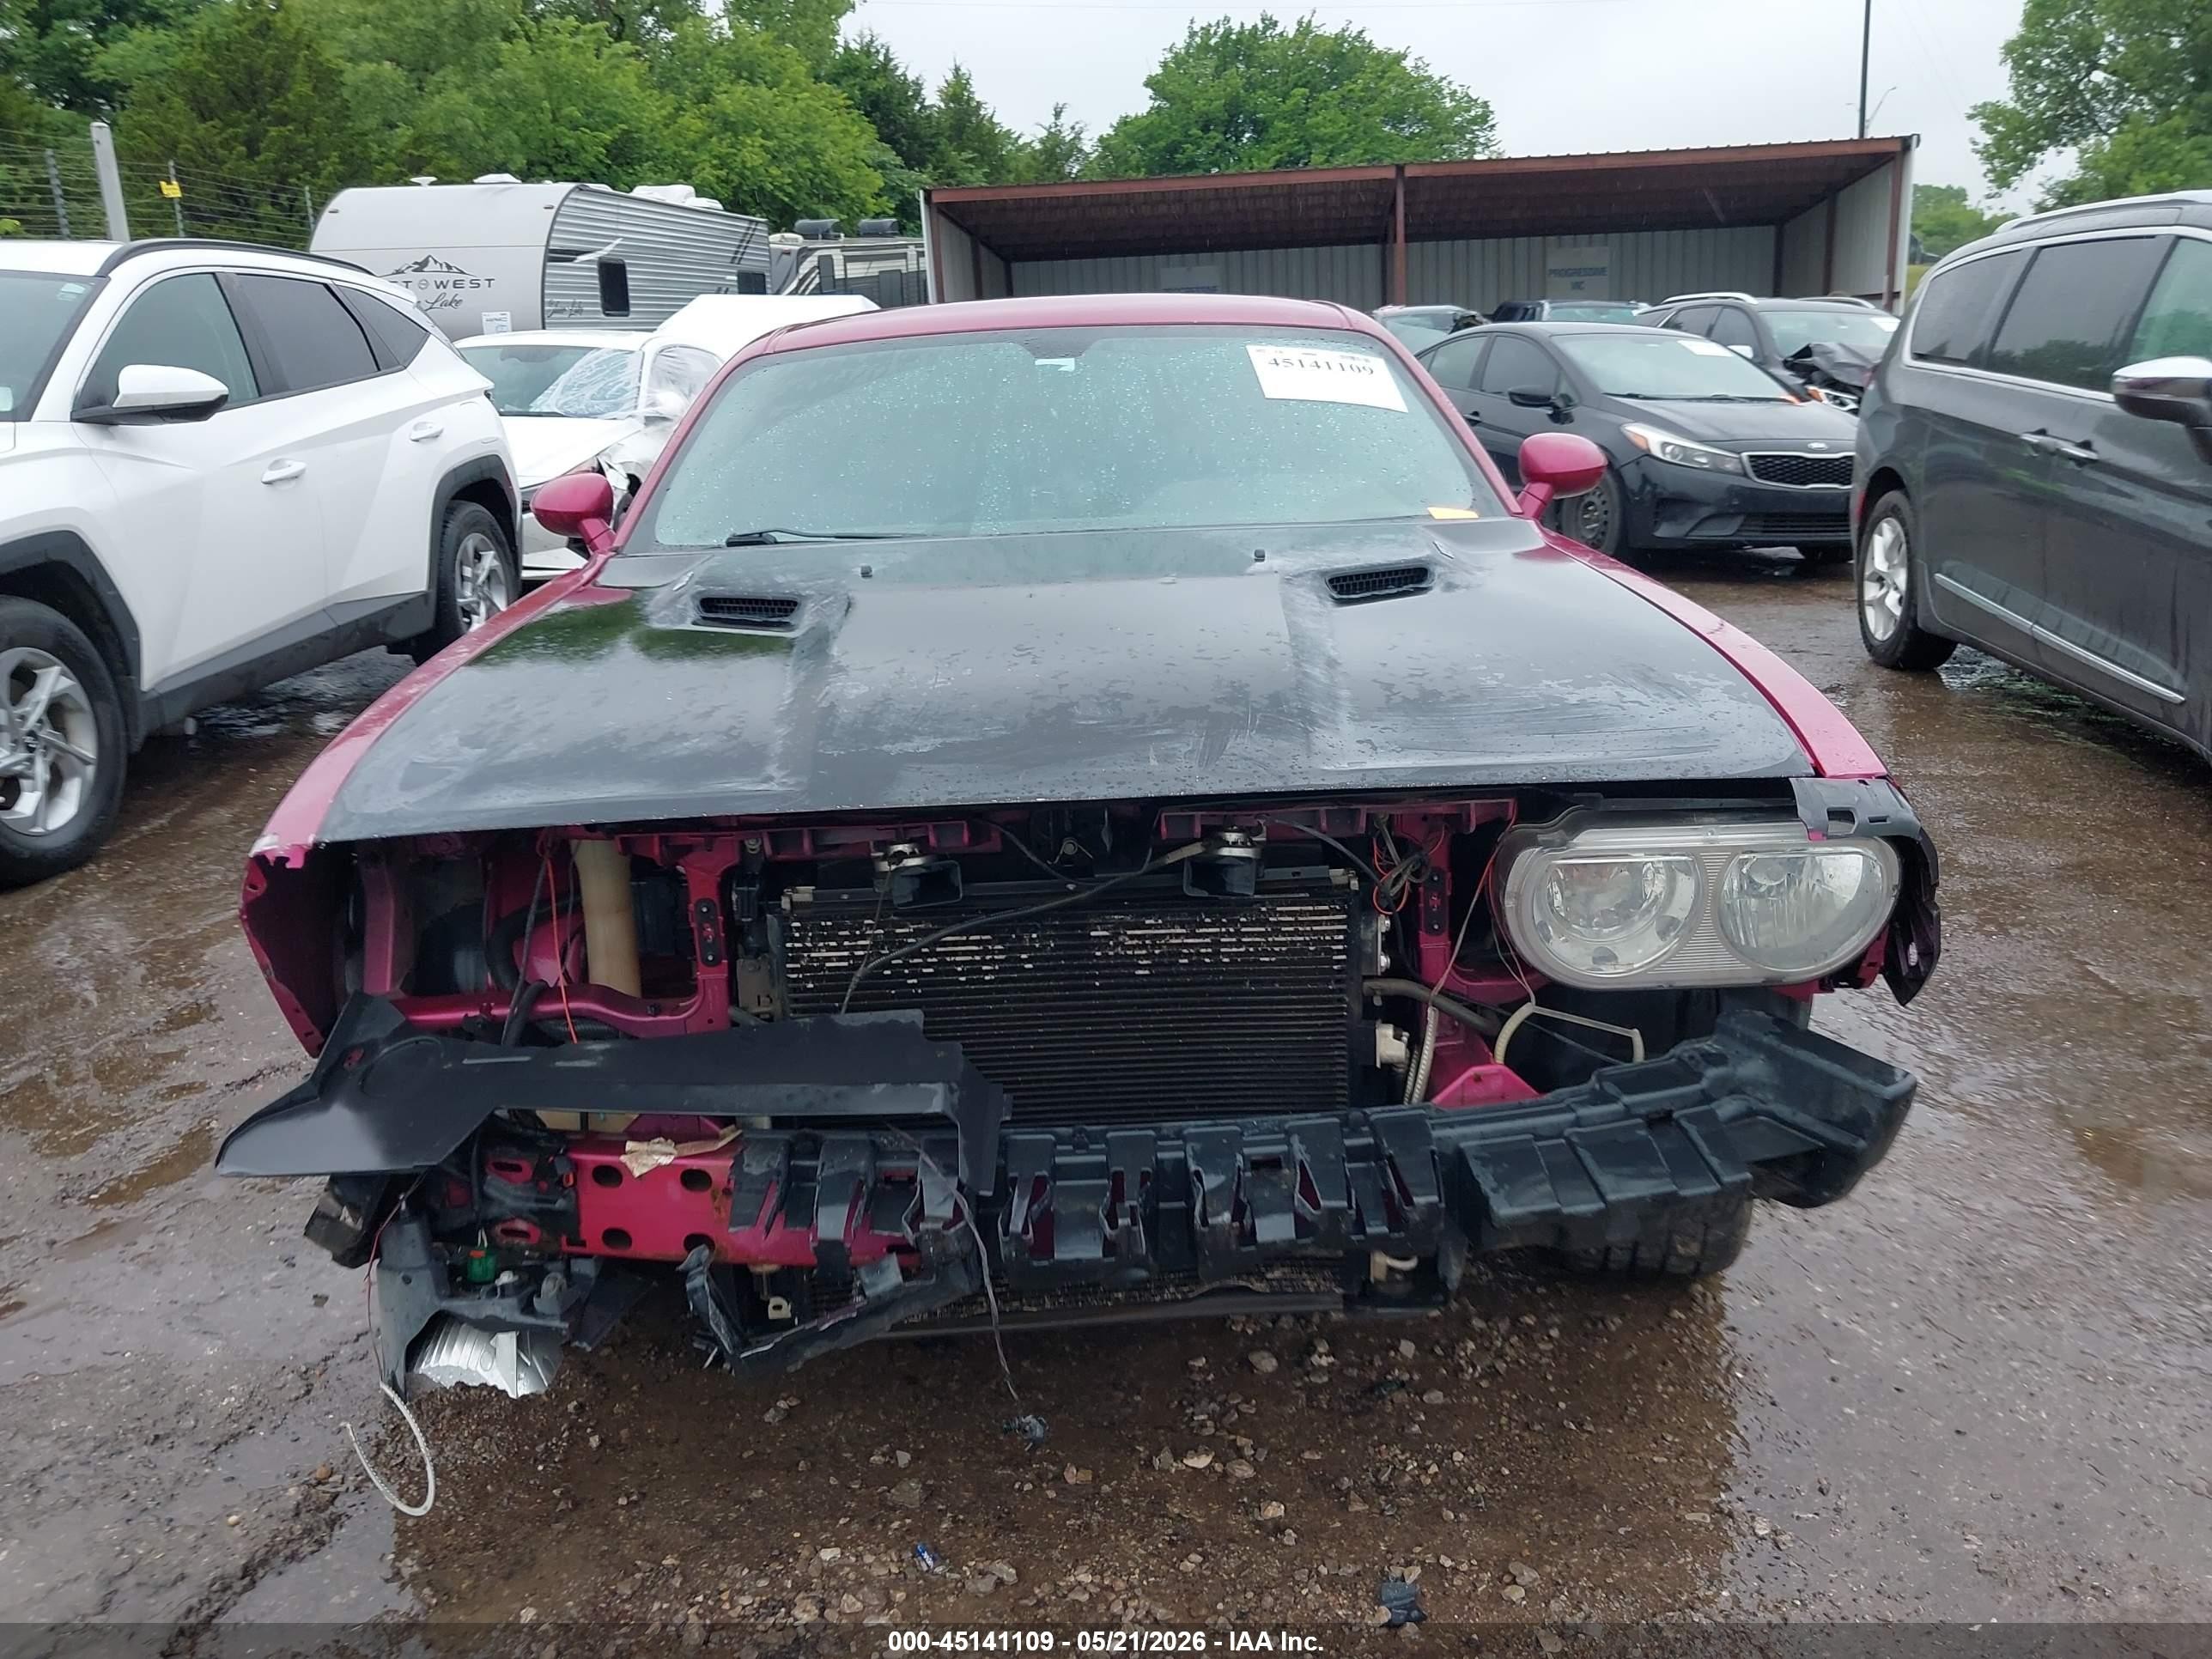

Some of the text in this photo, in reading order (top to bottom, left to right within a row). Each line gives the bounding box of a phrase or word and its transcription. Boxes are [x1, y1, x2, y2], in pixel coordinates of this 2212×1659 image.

[434, 278, 495, 290] WEST
[424, 292, 464, 312] Lake
[1268, 358, 1374, 376] 45141109
